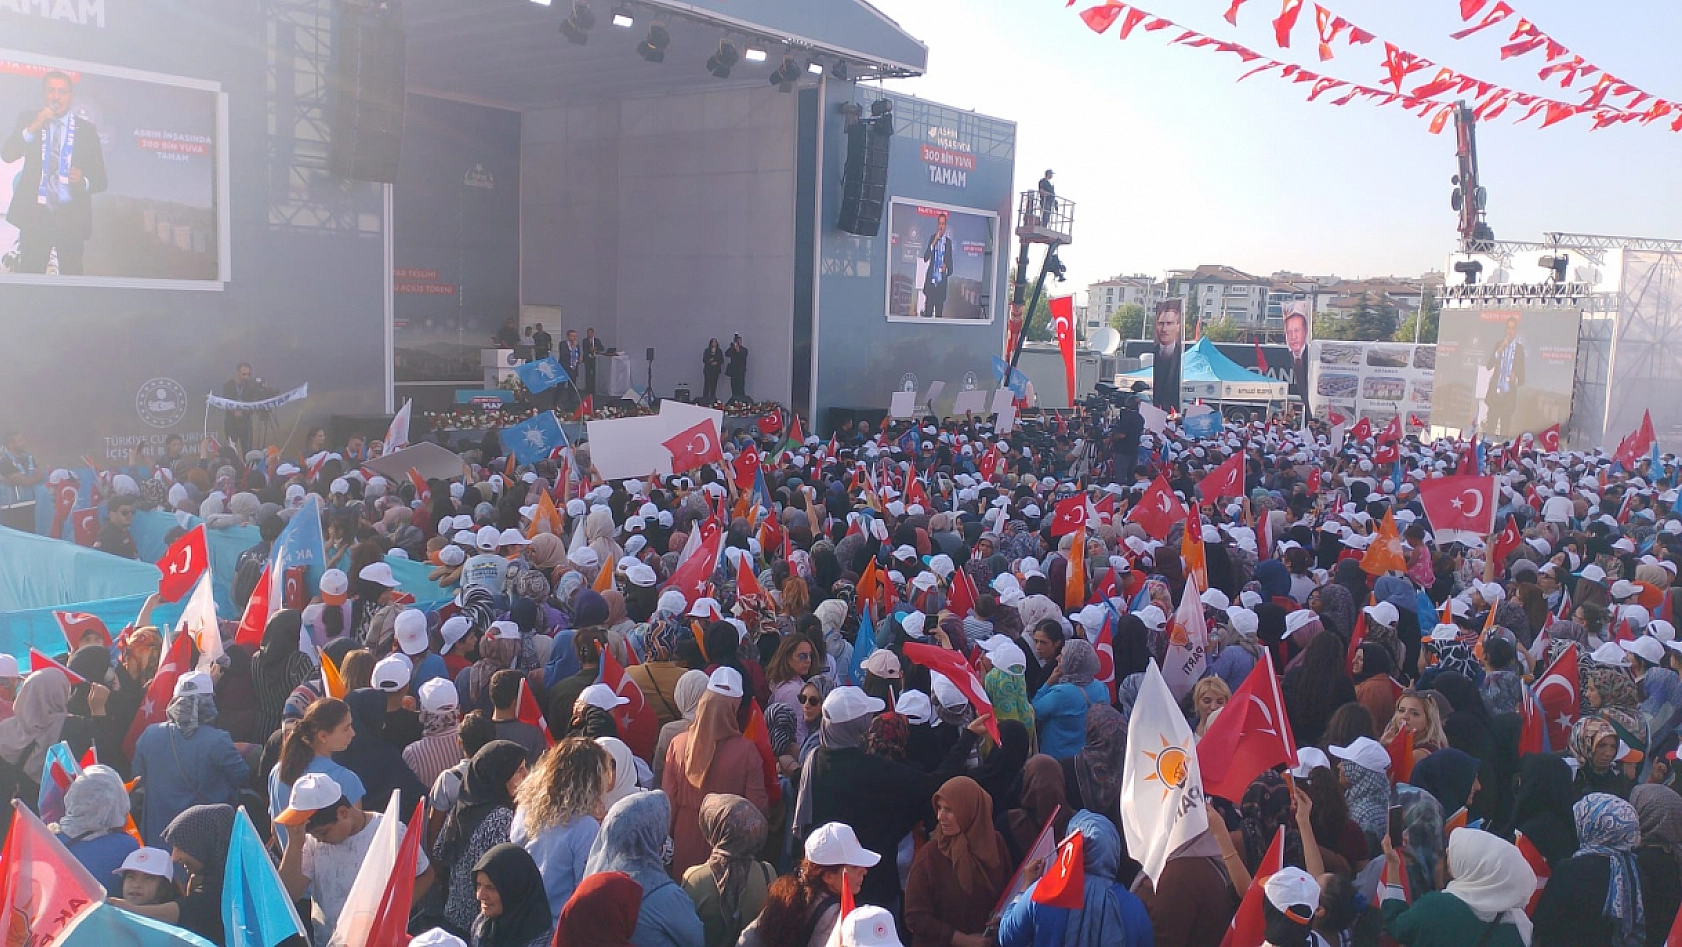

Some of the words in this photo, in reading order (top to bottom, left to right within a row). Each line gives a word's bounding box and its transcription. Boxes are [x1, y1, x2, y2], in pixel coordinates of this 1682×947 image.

[142, 139, 160, 149] 300
[179, 143, 203, 153] YUVA
[156, 151, 189, 163] TAMAM
[924, 148, 940, 162] 300
[929, 165, 967, 187] TAMAM
